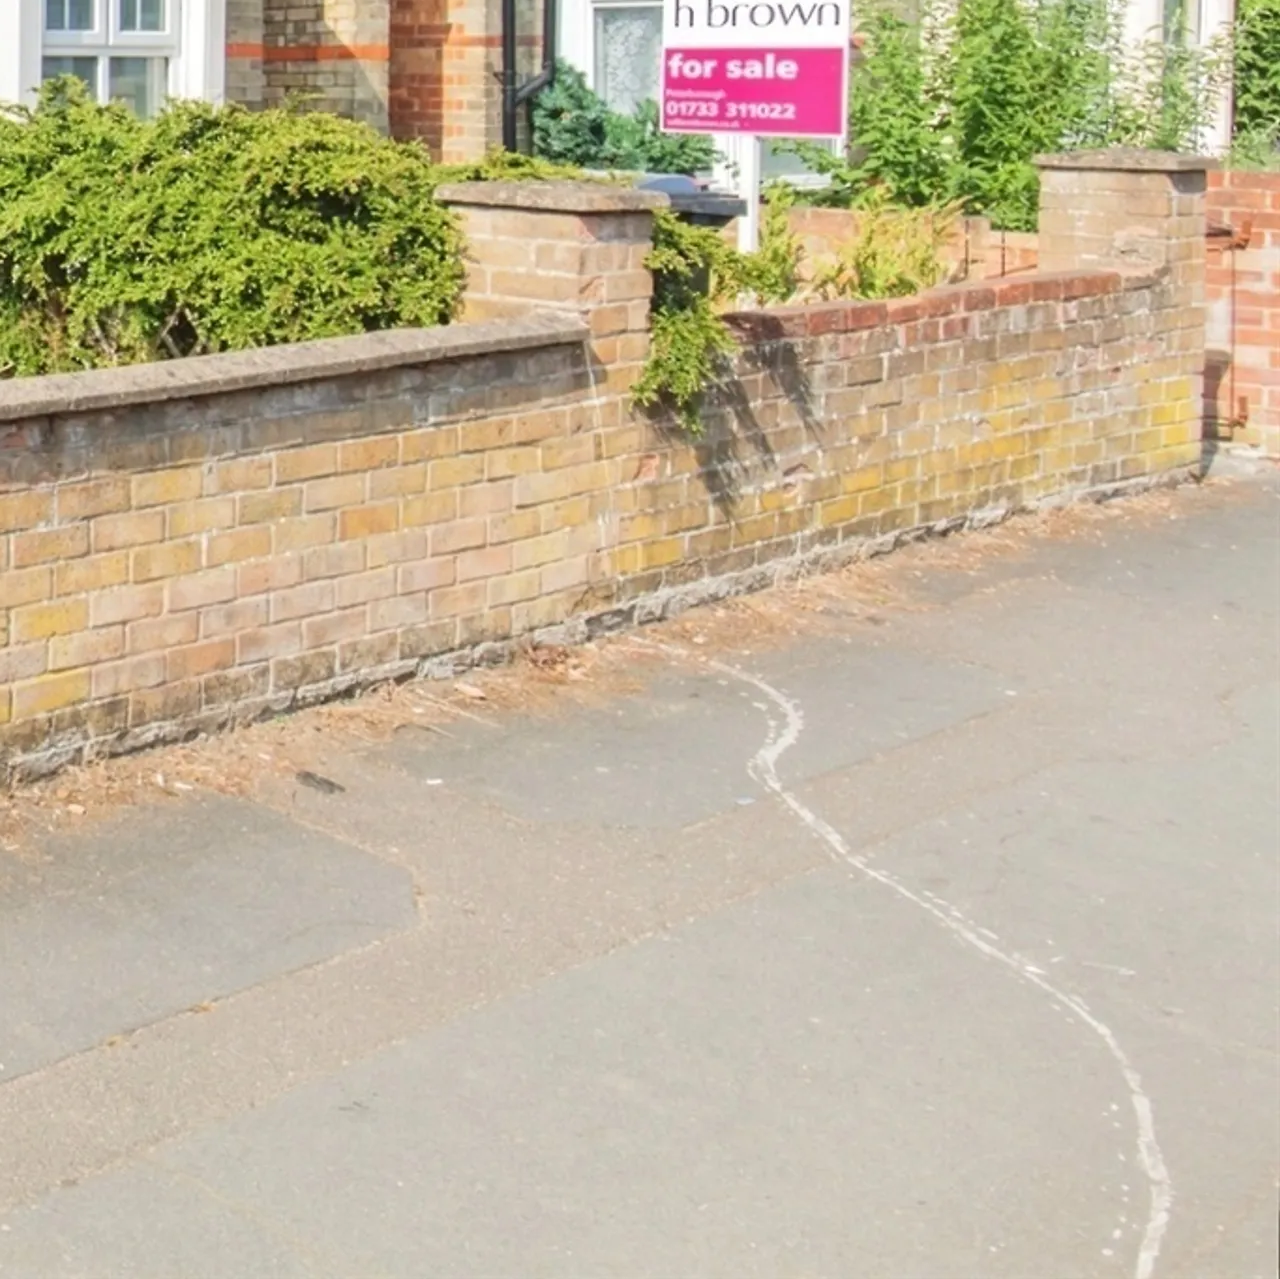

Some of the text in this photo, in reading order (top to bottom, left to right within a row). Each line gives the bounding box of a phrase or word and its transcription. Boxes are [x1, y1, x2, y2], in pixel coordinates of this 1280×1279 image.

[668, 52, 798, 80] for sale
[666, 100, 796, 120] 01733 311022
